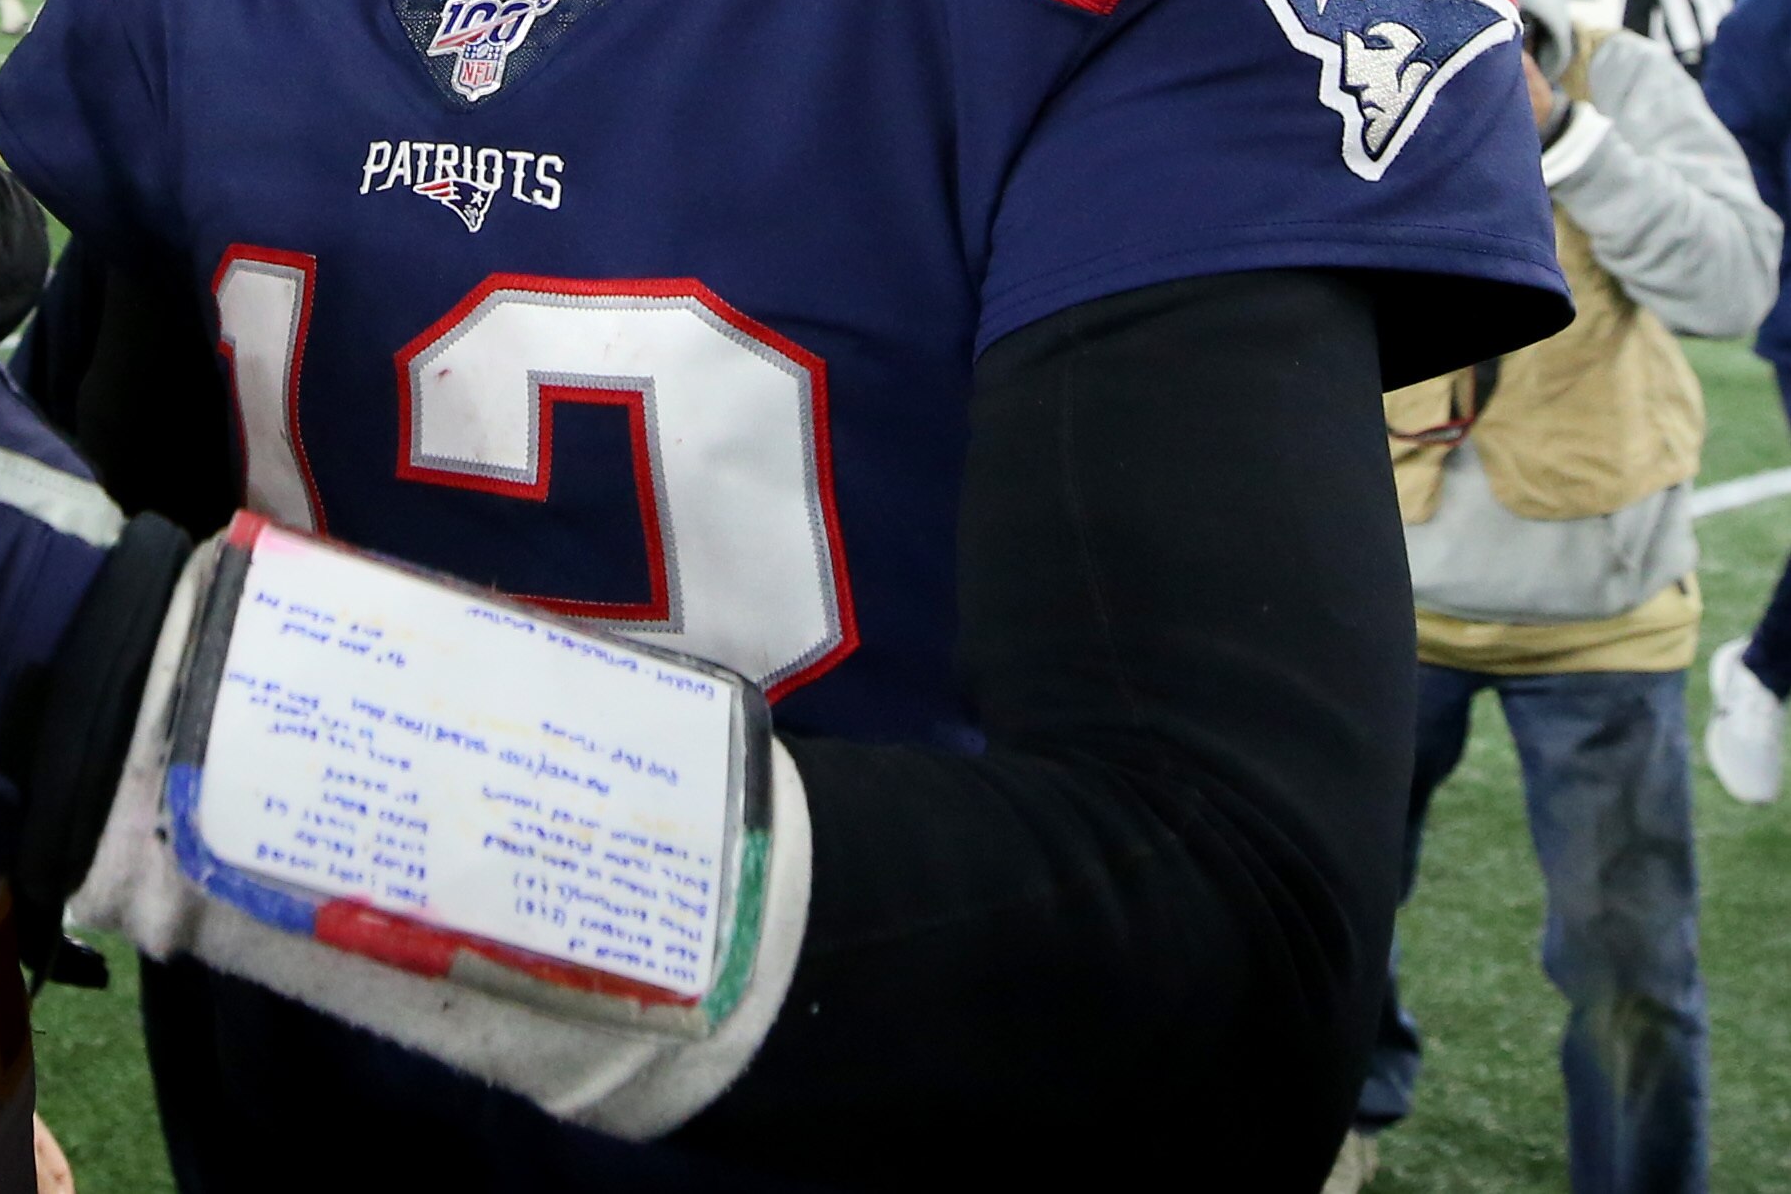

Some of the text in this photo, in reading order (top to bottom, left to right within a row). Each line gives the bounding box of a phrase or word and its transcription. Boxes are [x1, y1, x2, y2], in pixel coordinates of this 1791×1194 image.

[440, 1, 530, 43] 100
[462, 61, 494, 85] NFL
[360, 140, 564, 210] PATRIOTS
[211, 244, 859, 696] 12
